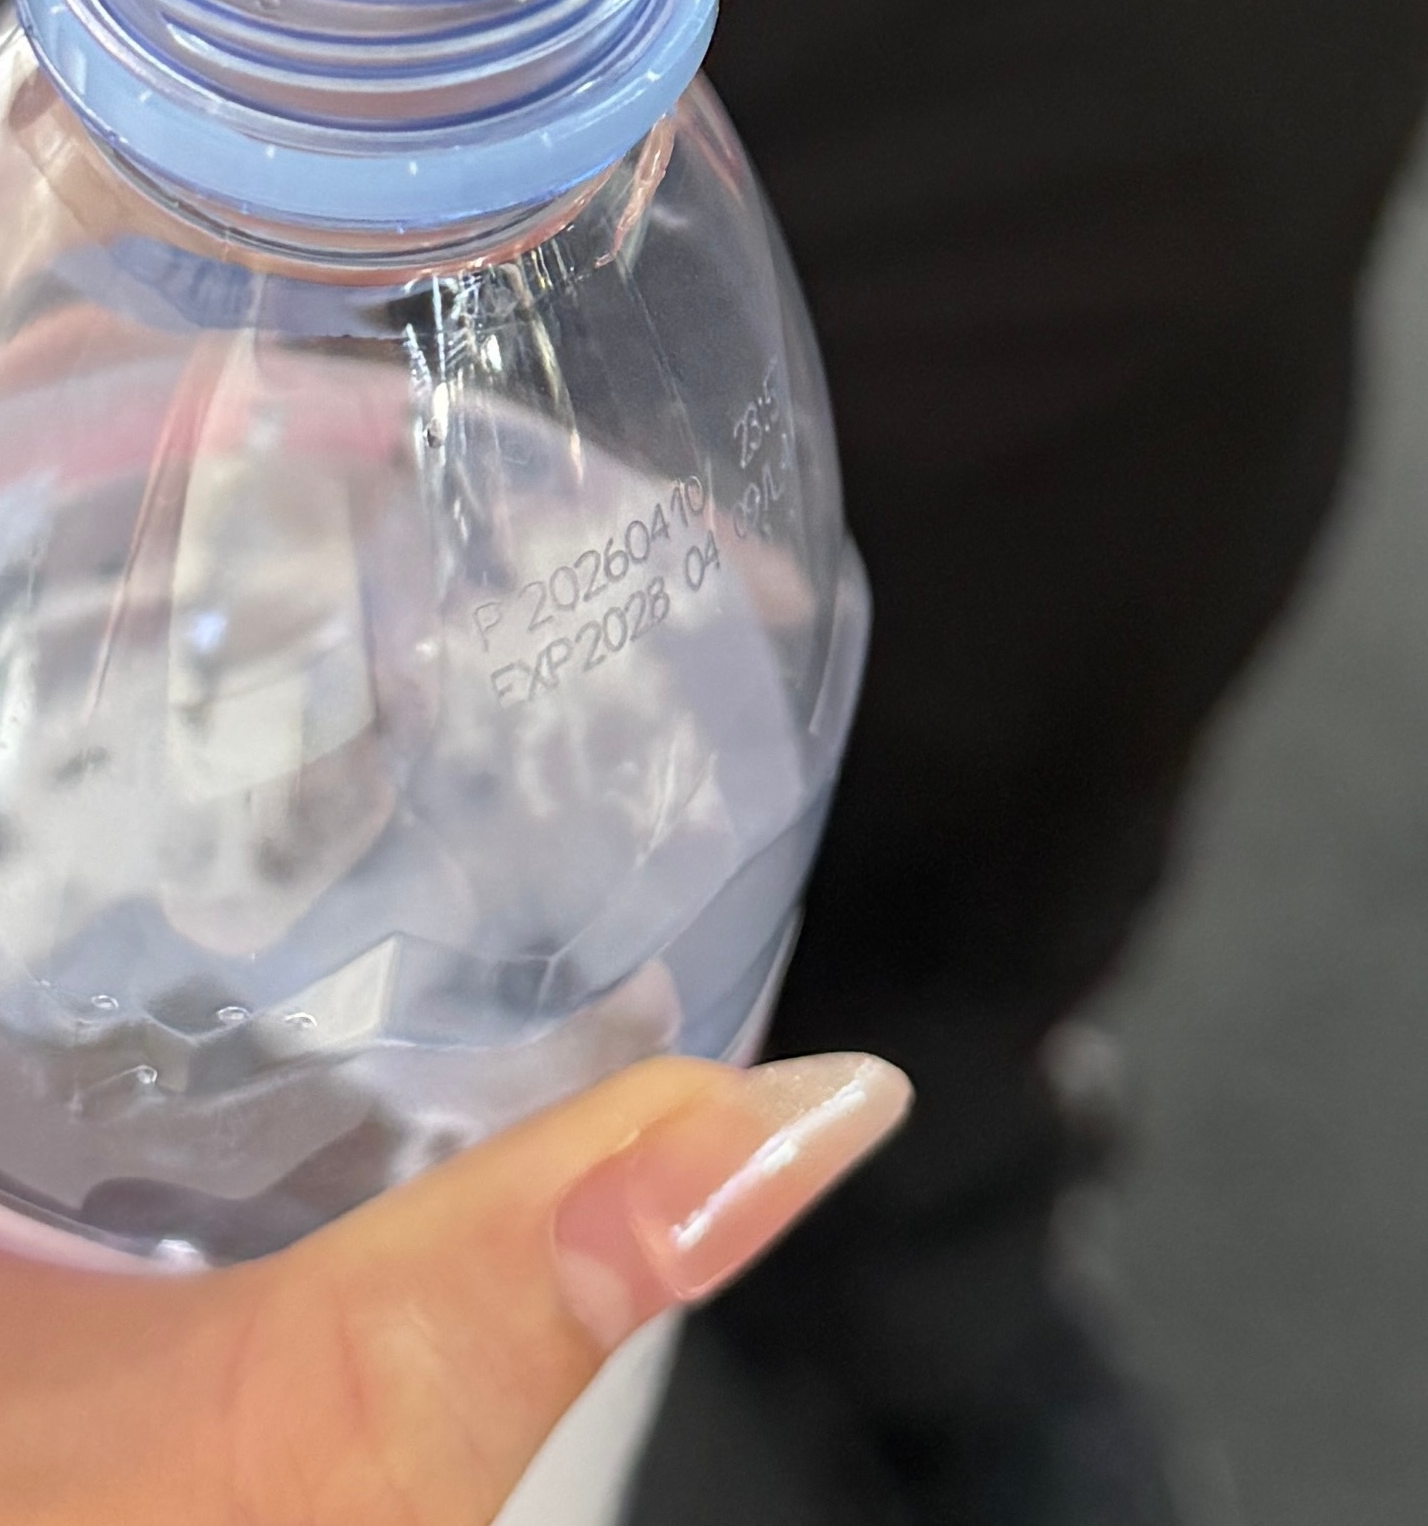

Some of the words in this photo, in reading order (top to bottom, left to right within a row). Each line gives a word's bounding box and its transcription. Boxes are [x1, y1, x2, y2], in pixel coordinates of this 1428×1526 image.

[473, 600, 504, 653] P
[519, 474, 707, 633] 20260410
[683, 529, 721, 593] 04
